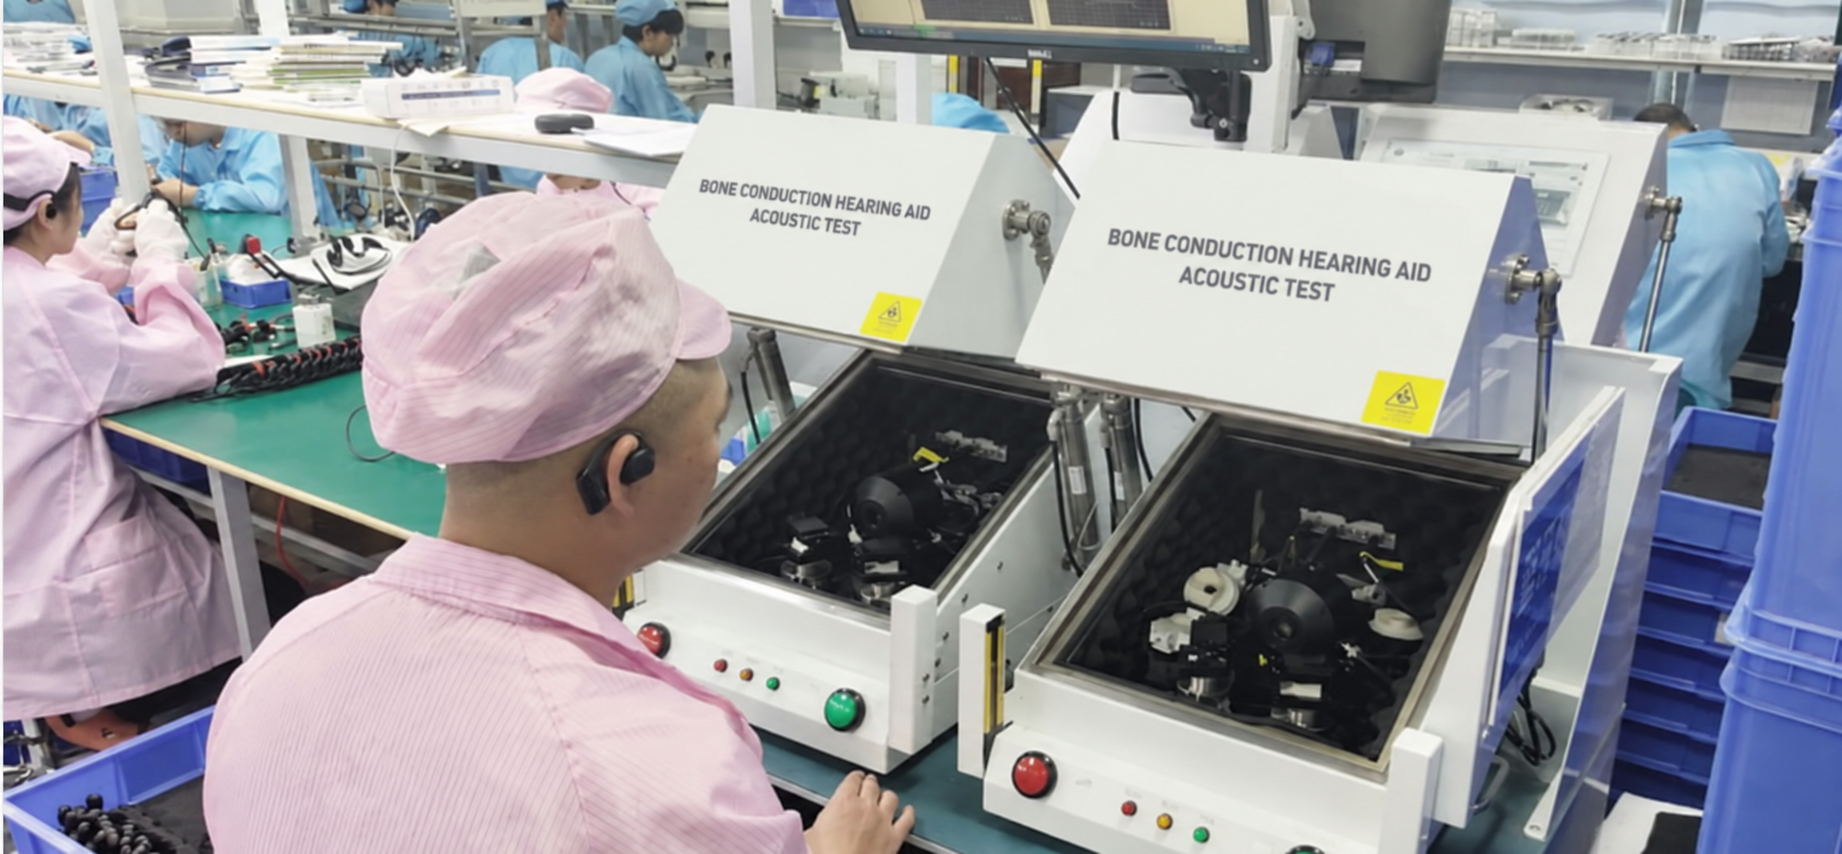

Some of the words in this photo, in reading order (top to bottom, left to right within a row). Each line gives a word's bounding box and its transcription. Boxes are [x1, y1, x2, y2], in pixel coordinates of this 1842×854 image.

[699, 179, 738, 196] BONE
[740, 183, 833, 208] CONDUCTION
[834, 195, 902, 217] HEARING
[904, 204, 931, 220] AID
[749, 208, 822, 231] ACOUSTIC
[824, 217, 862, 236] TEST
[1107, 228, 1161, 250] BONE
[1164, 234, 1294, 265] CONDUCTION
[1298, 249, 1391, 277] HEARING
[1395, 261, 1432, 282] AID
[1178, 266, 1280, 295] ACOUSTIC
[1284, 278, 1336, 301] TEST
